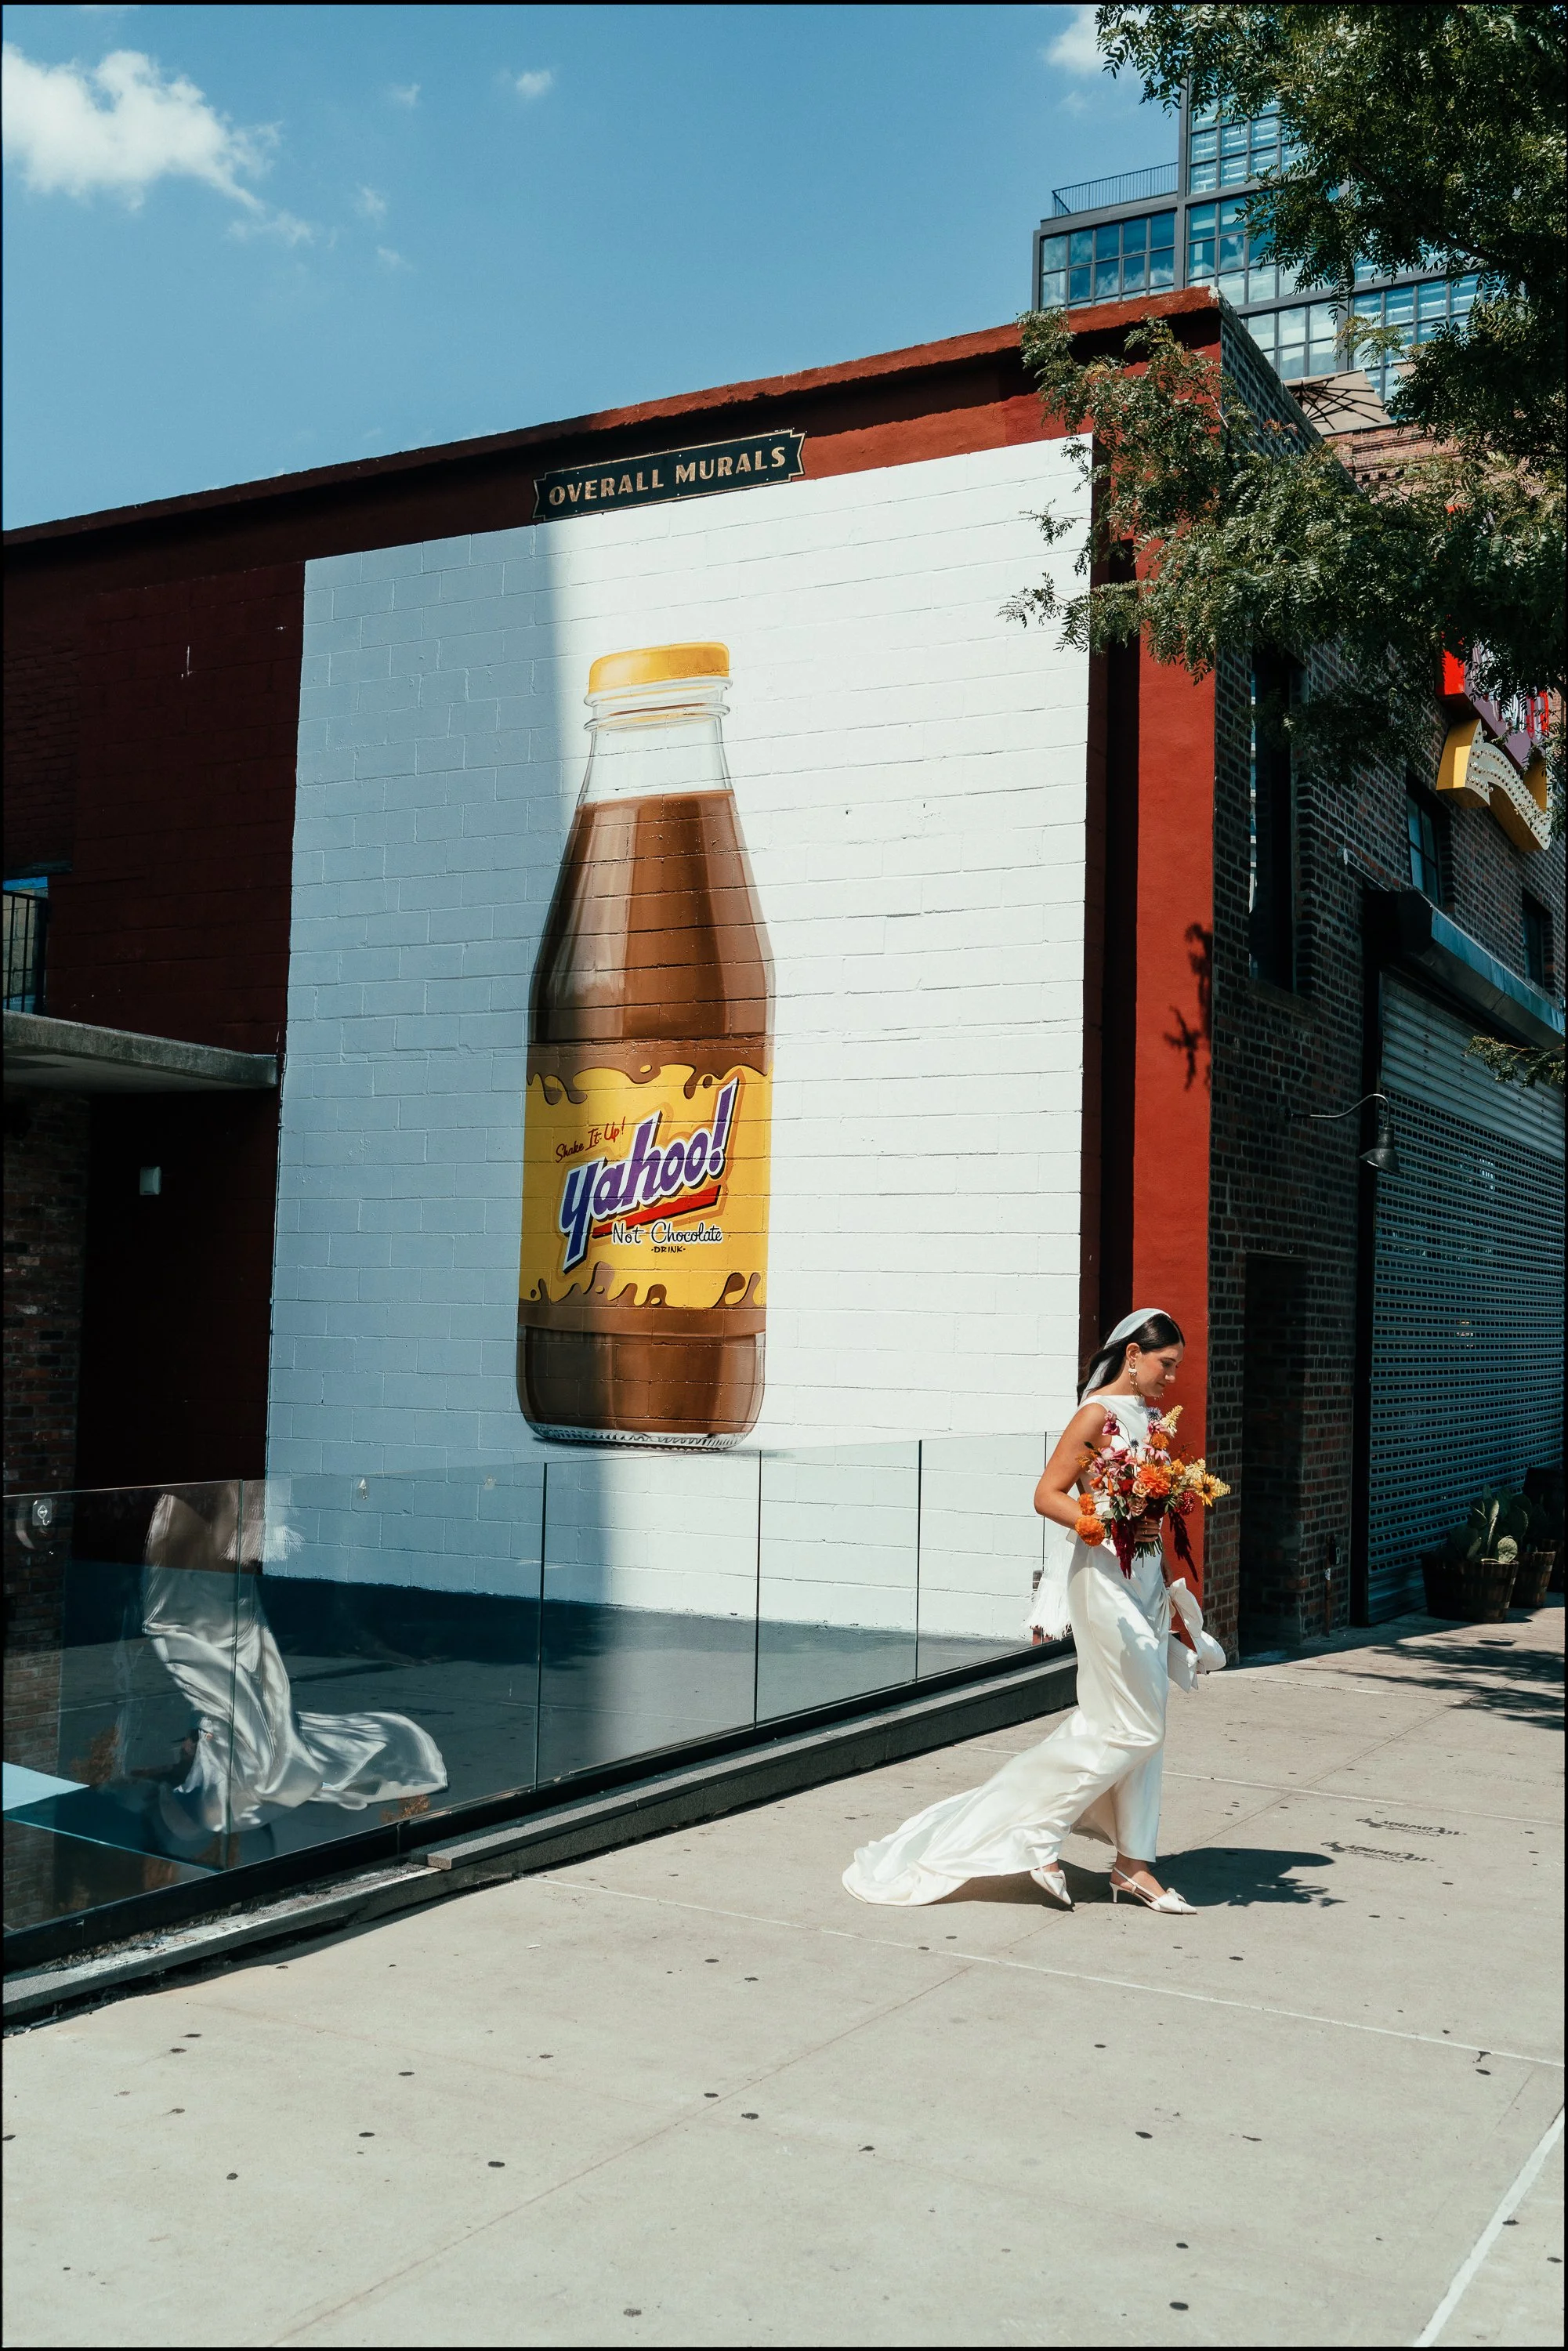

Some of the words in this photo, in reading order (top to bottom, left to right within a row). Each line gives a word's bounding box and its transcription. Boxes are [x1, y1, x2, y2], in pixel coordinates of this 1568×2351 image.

[549, 469, 664, 505] OVERALL
[675, 447, 786, 484] MURALS
[555, 1141, 585, 1163] Shake
[585, 1128, 602, 1151] It
[603, 1116, 625, 1143] Up!
[613, 1223, 644, 1244] Not
[651, 1221, 723, 1244] Chocolate
